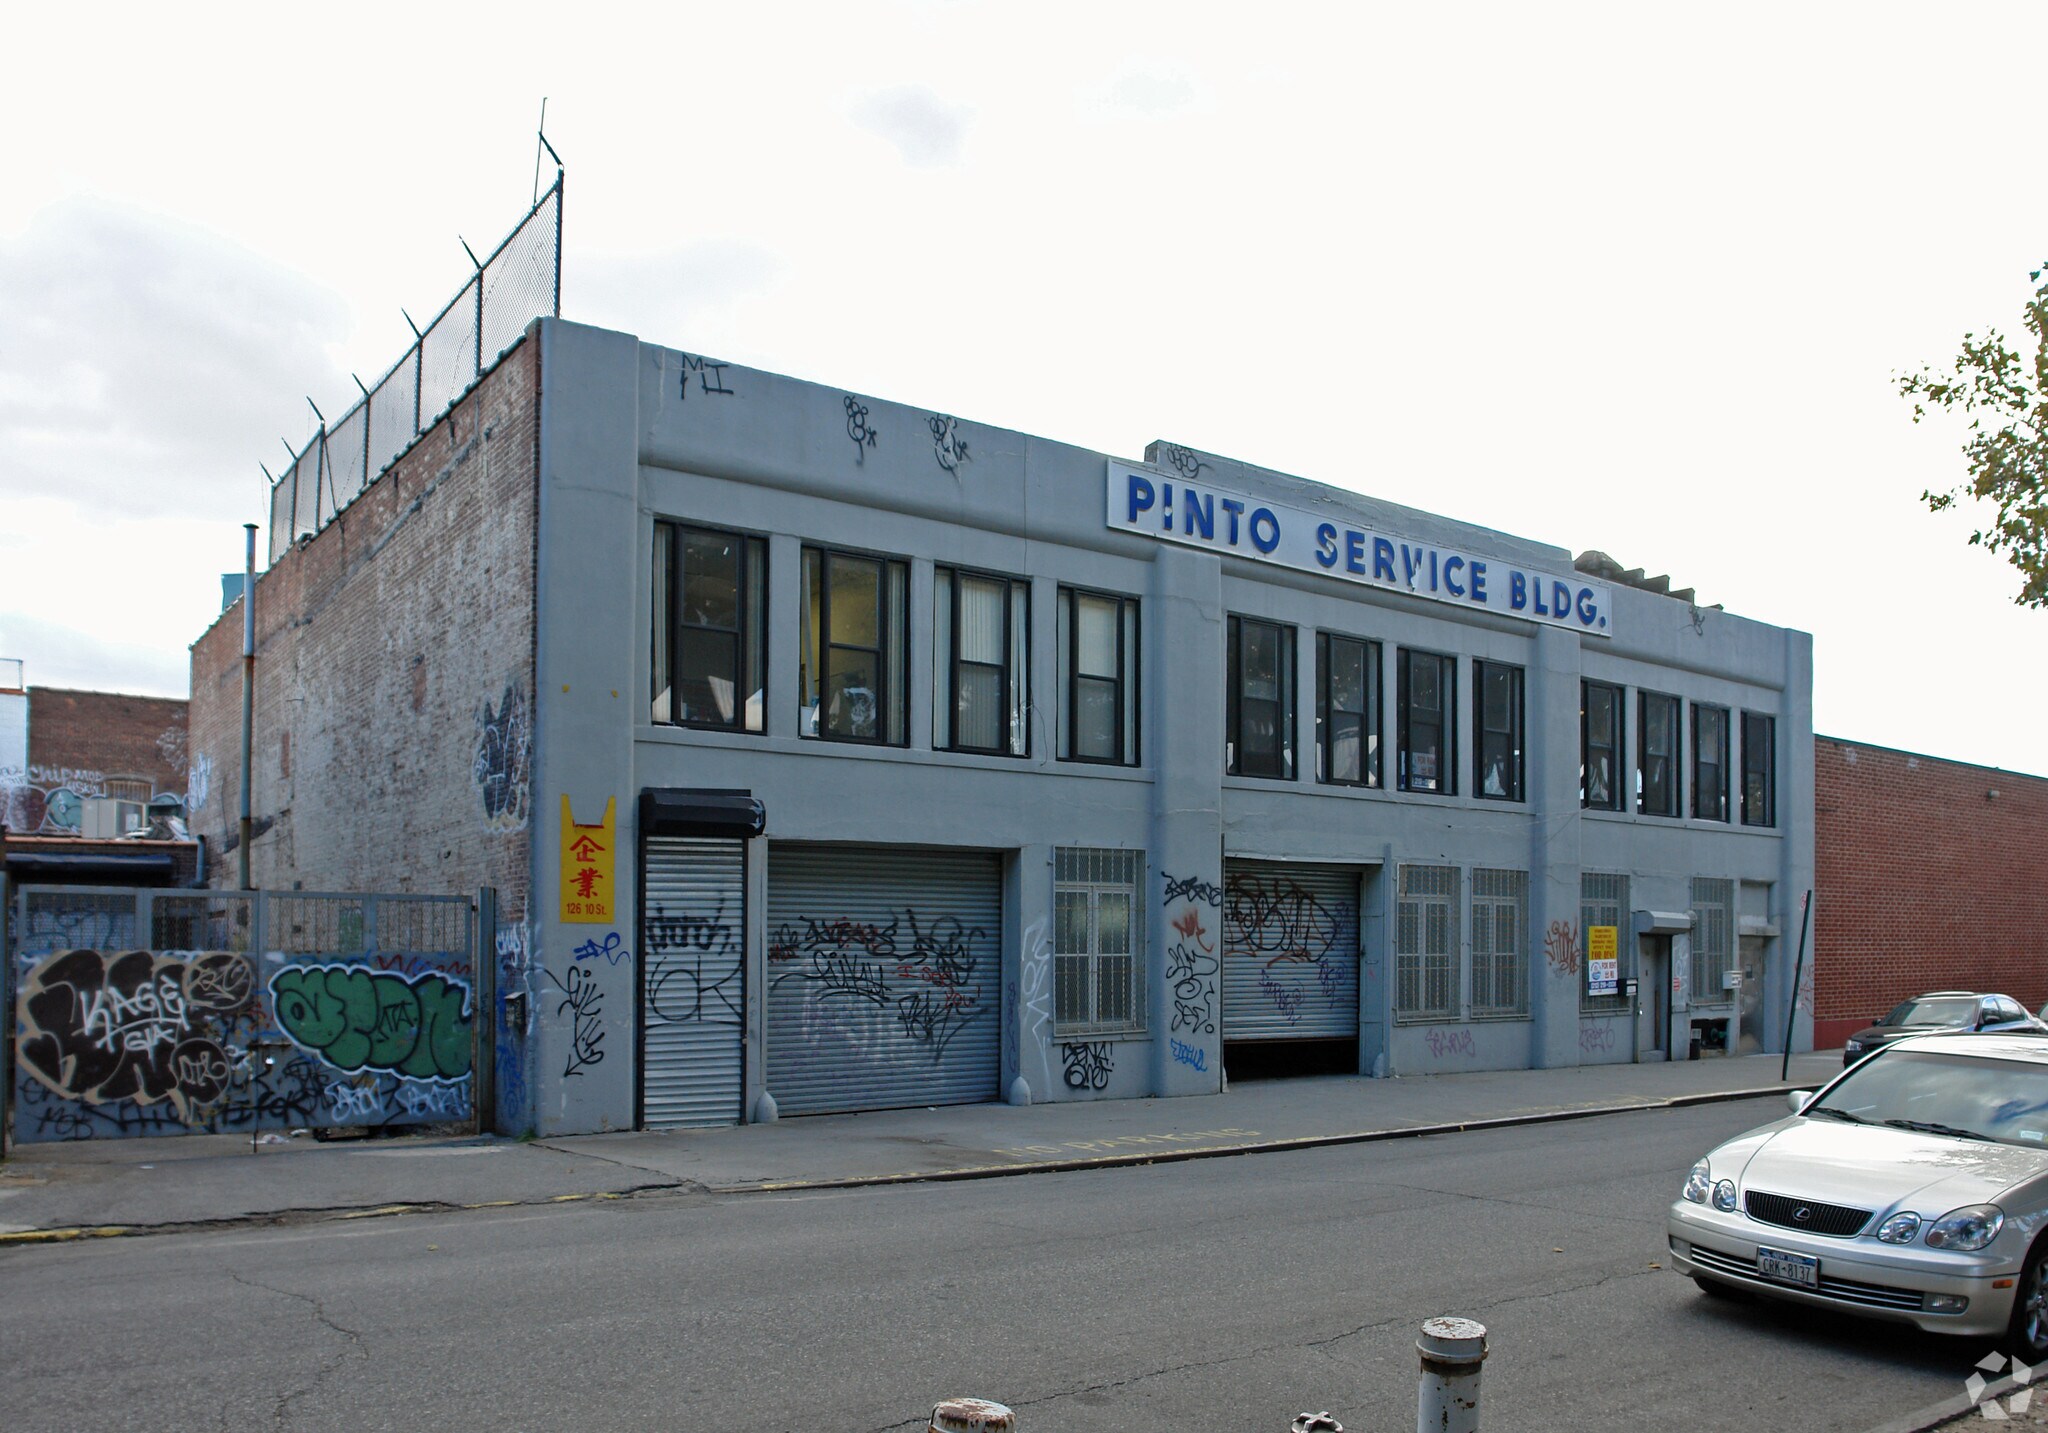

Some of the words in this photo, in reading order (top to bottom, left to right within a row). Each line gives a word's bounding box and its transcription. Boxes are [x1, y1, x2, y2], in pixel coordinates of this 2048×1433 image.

[1128, 475, 1280, 554] PINTO
[1316, 523, 1487, 602] SERVICE
[1510, 570, 1606, 627] BLDG.
[569, 834, 606, 899] 企業
[566, 903, 582, 915] 126
[585, 903, 594, 915] 10
[595, 903, 607, 915] St.
[993, 1144, 1062, 1158] NO
[1062, 1127, 1263, 1153] PARKING
